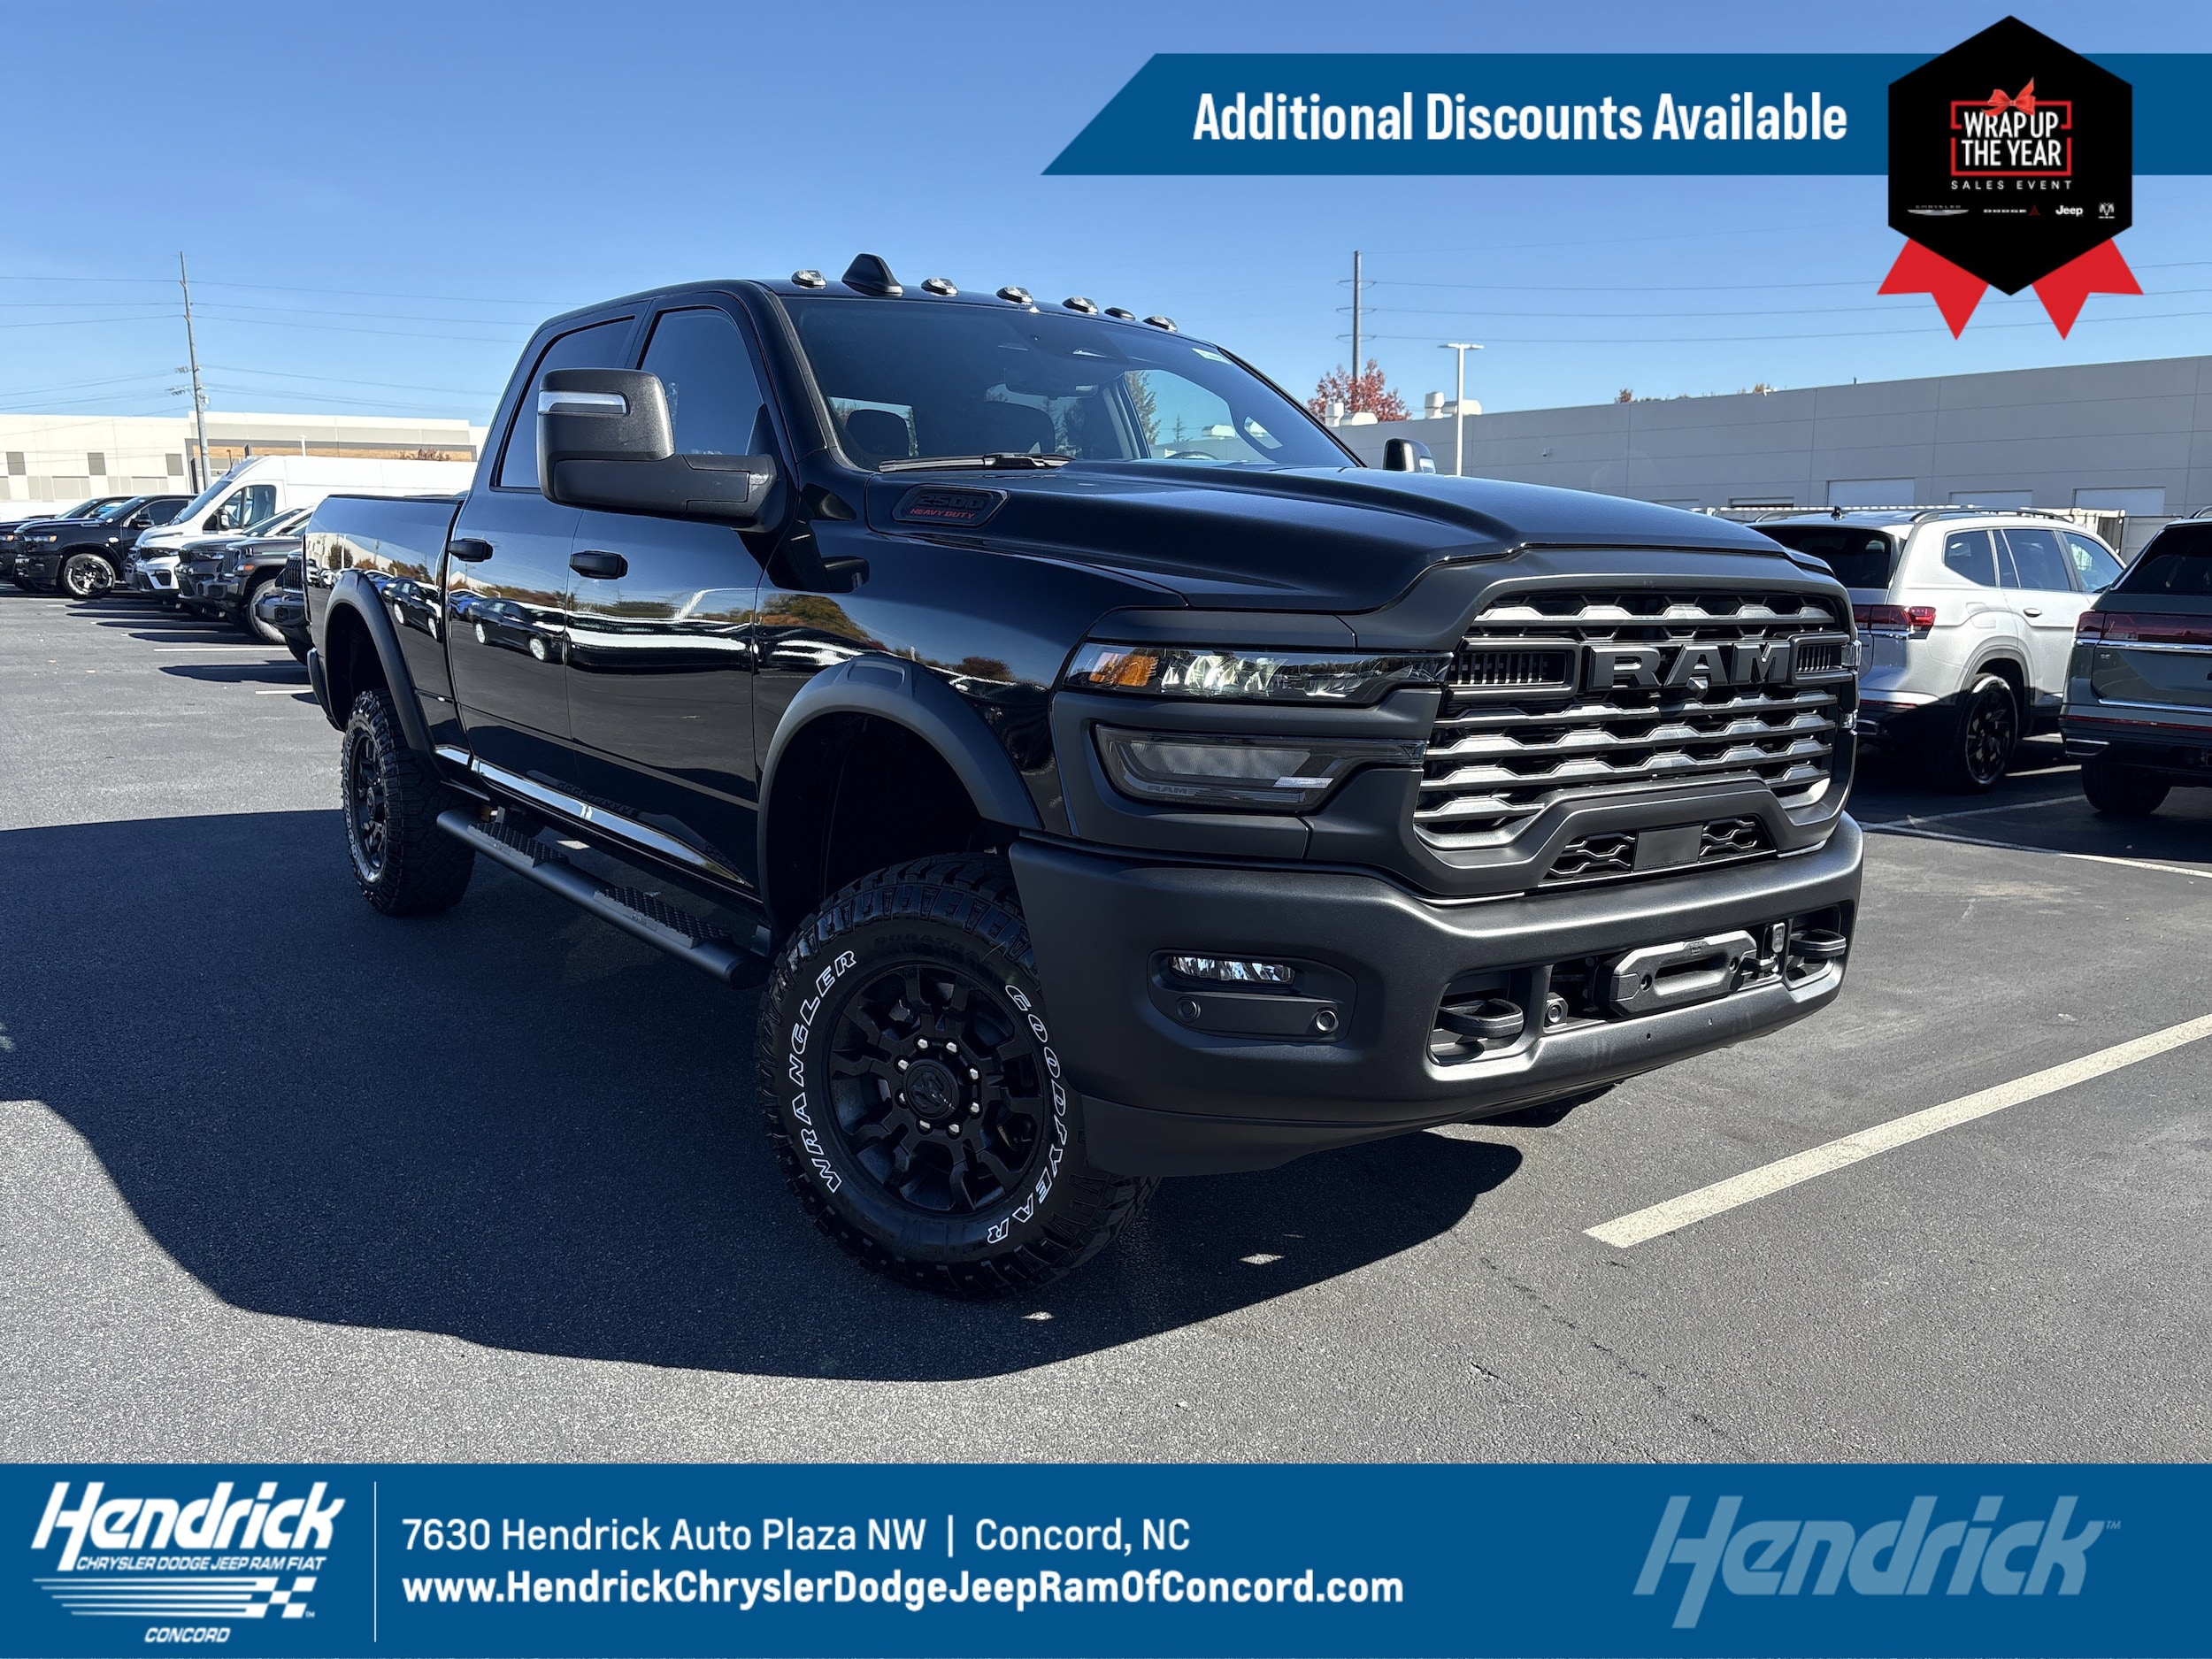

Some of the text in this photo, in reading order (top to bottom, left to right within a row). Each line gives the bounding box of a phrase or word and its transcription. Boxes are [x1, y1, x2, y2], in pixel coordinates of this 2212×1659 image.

[918, 494, 984, 510] 2500
[944, 511, 976, 519] DUTY
[1587, 641, 1791, 689] RAM
[1147, 784, 1187, 795] RAM
[787, 949, 857, 1194] WRANGLER
[986, 983, 1069, 1244] GOODYEAR
